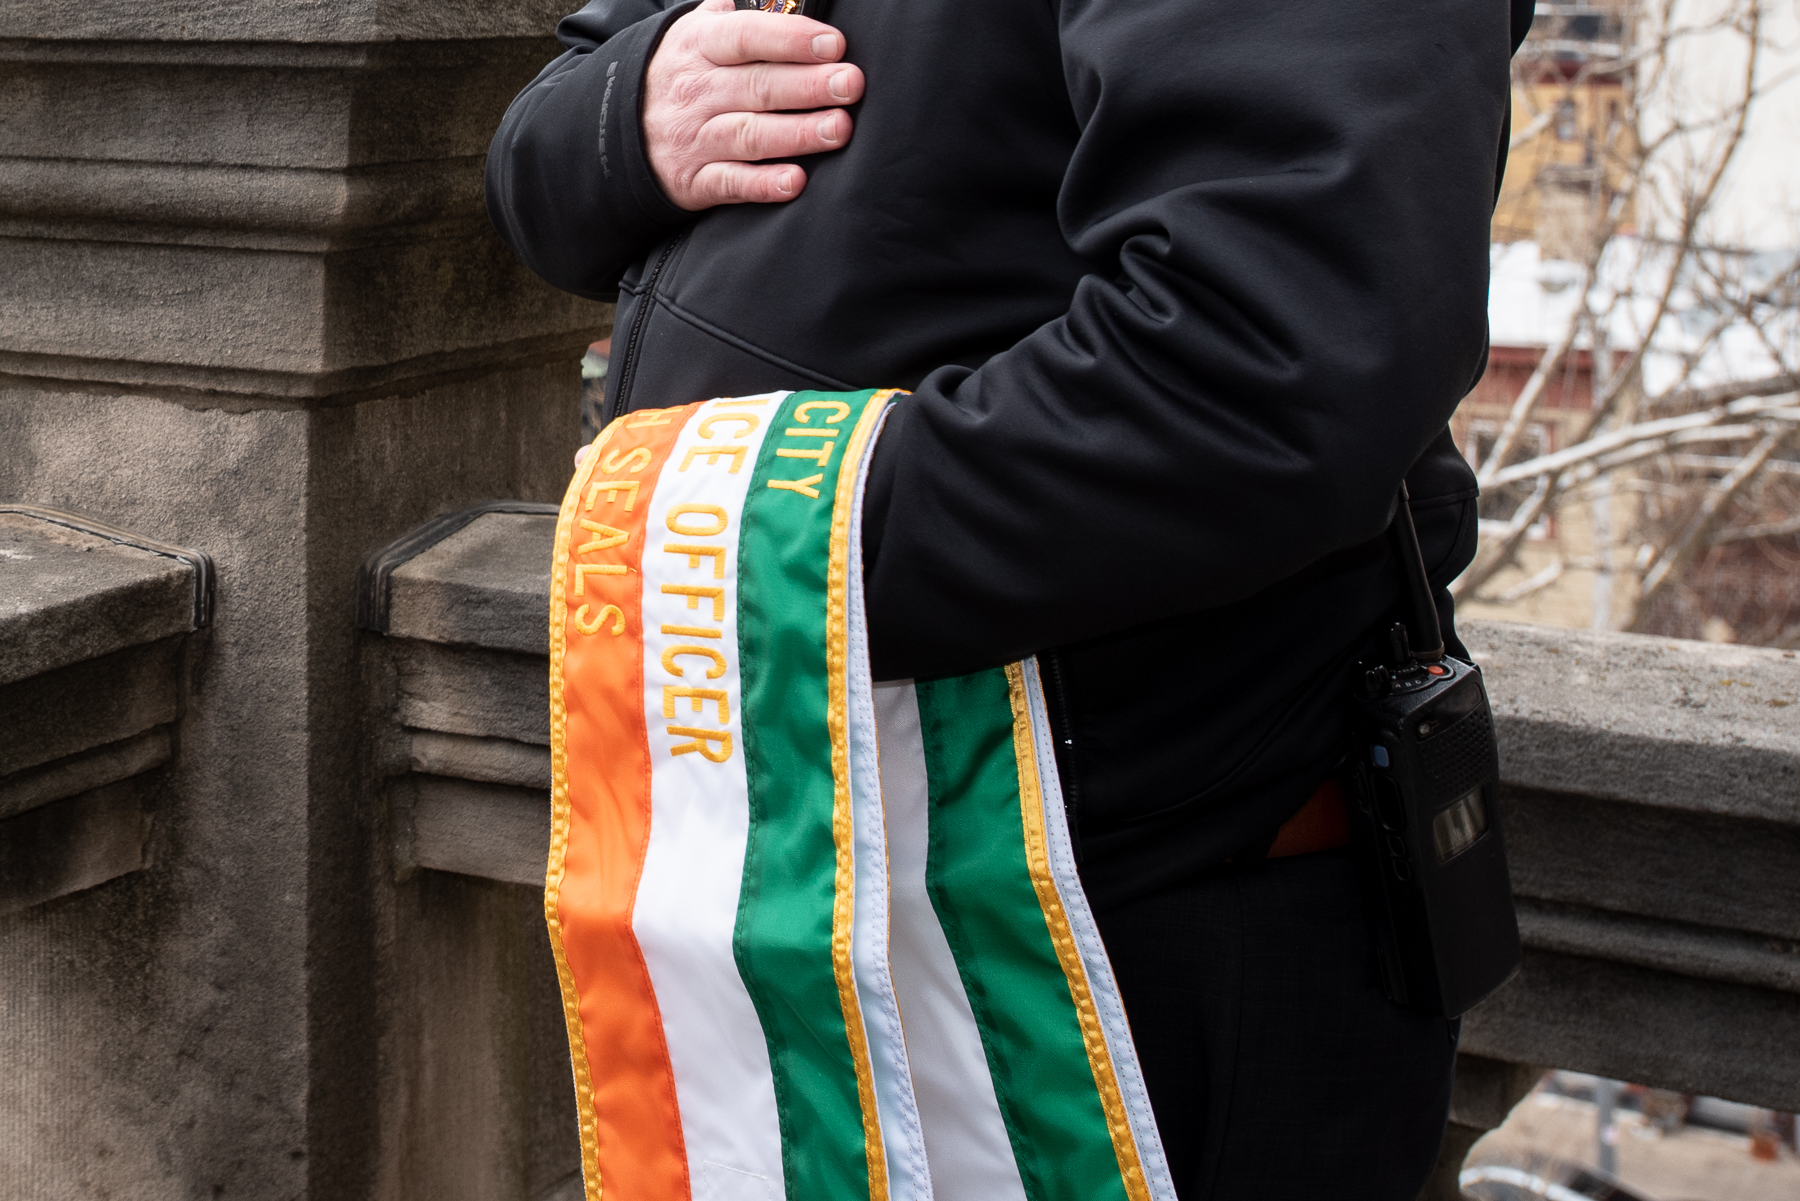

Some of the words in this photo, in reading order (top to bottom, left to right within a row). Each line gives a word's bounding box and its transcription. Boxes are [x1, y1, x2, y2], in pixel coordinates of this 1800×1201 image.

[626, 408, 683, 429] H
[767, 400, 851, 499] CITY
[574, 446, 652, 636] SEALS
[661, 502, 733, 763] OFFICER
